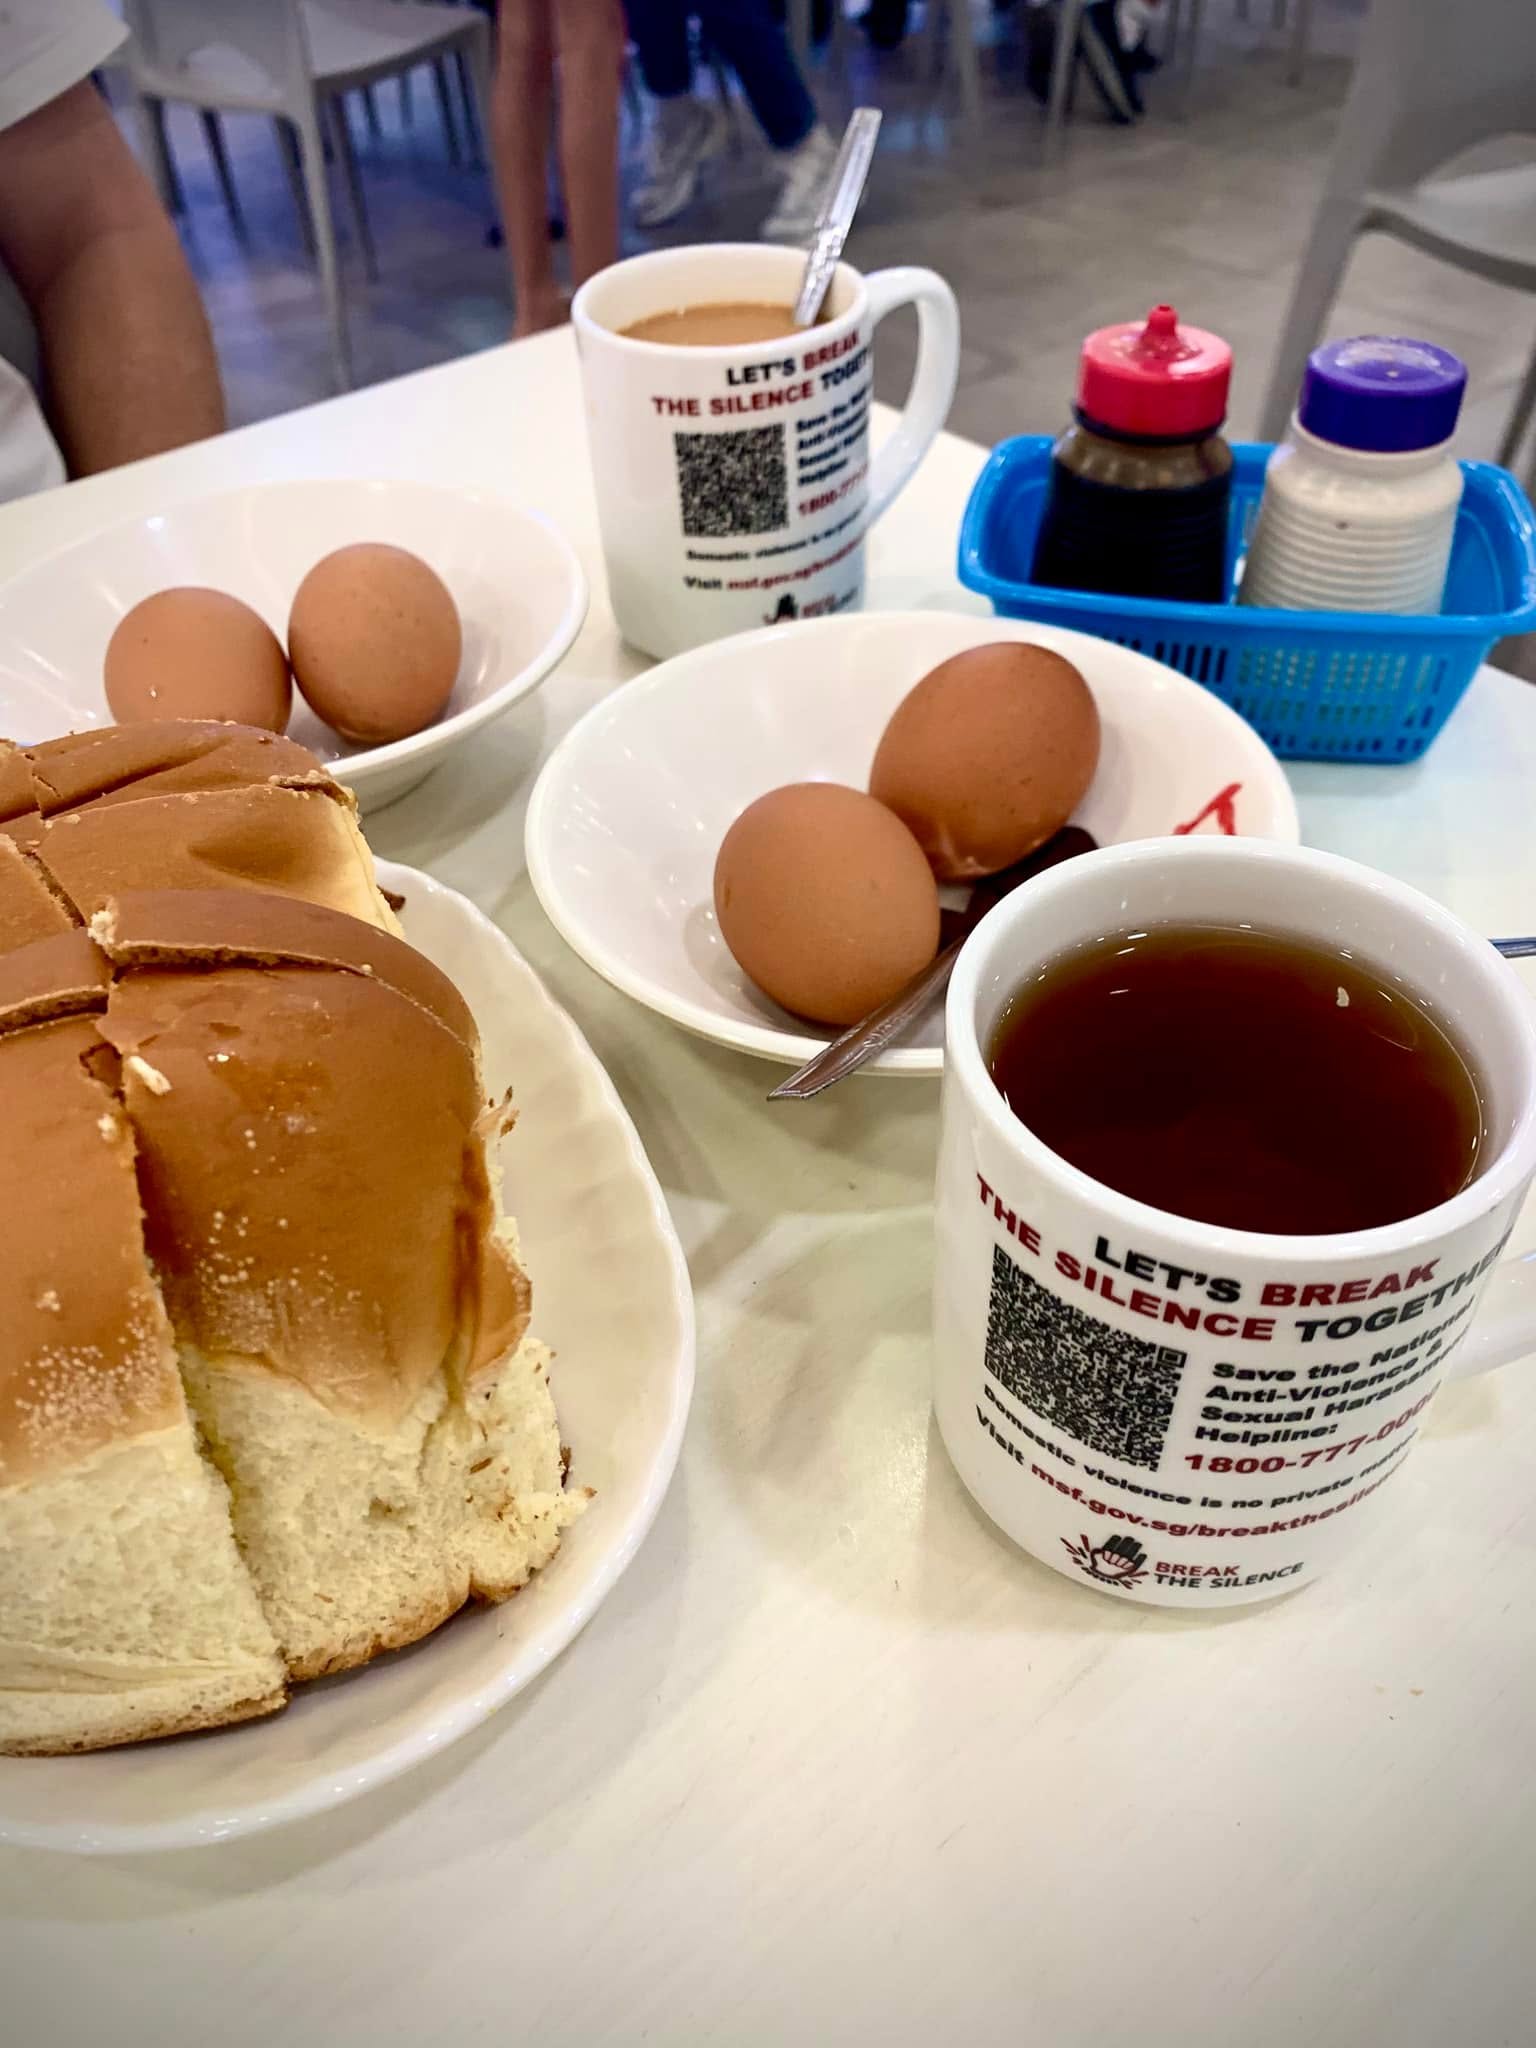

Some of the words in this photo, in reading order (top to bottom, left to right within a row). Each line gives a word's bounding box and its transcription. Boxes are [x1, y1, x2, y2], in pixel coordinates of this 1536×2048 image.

[727, 357, 796, 386] LET'S
[651, 396, 702, 417] THE
[709, 380, 814, 416] SILENCE
[684, 575, 722, 590] Visit
[976, 1172, 1041, 1257] THE
[1054, 1251, 1277, 1342] SILENCE
[1095, 1236, 1241, 1304] LET'S
[1260, 1258, 1441, 1308] BREAK
[1213, 1363, 1297, 1382] Save
[1308, 1361, 1360, 1380] the
[1369, 1294, 1476, 1367] National
[1206, 1356, 1419, 1403] Anti-Violence
[976, 1404, 1025, 1466] Visit
[1184, 1380, 1442, 1475] 1800-777-000
[1194, 1423, 1339, 1448] Helpline:
[1200, 1406, 1315, 1424] Sexual
[984, 1384, 1077, 1467] Domestic
[1083, 1465, 1192, 1505] violence
[1200, 1497, 1223, 1509] is
[1231, 1500, 1264, 1509] no
[1270, 1476, 1354, 1509] private
[1153, 1573, 1203, 1589] THE
[1209, 1562, 1305, 1589] SILENCE
[1154, 1561, 1241, 1577] BREAK
